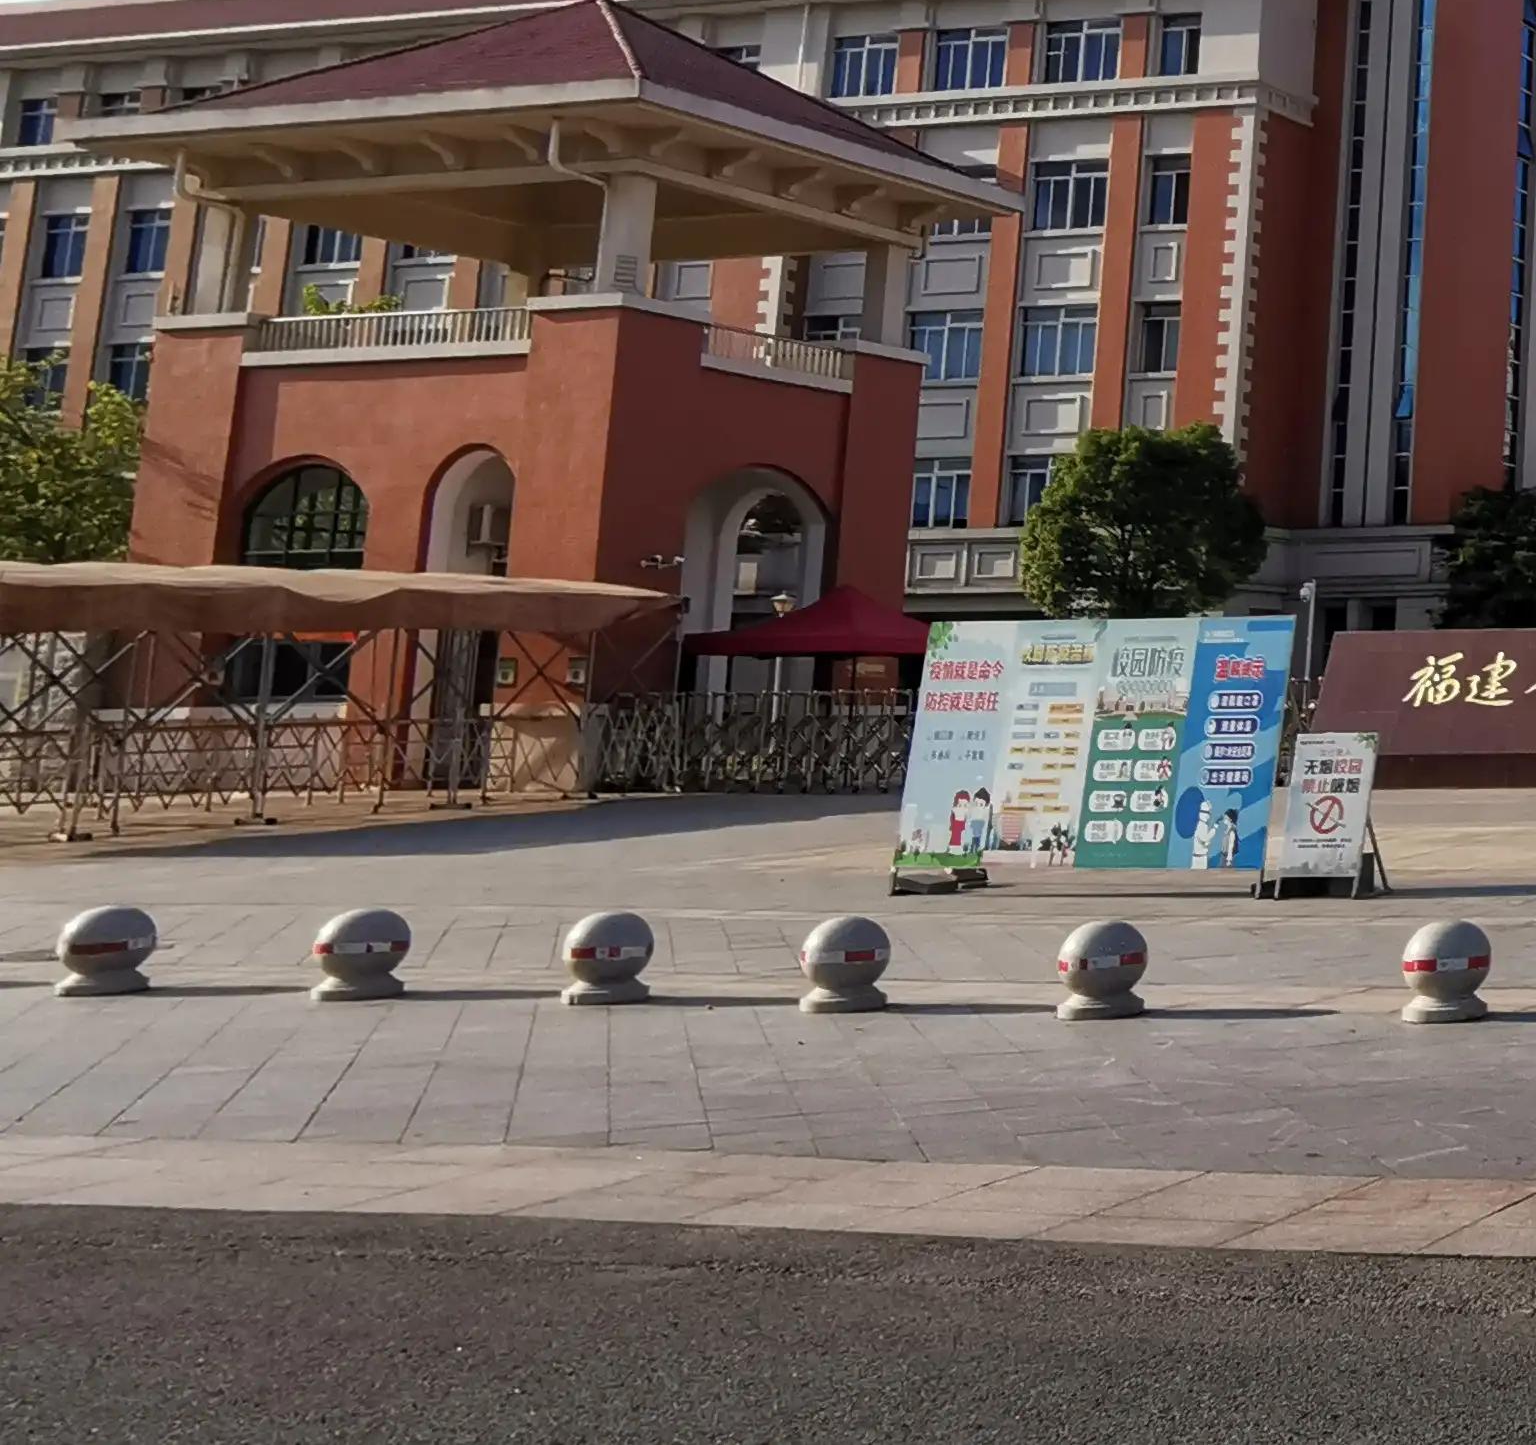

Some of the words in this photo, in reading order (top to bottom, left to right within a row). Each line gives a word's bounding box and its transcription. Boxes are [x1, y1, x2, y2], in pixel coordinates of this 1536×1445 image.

[930, 660, 1004, 681] 疫情就是命令
[1111, 646, 1186, 678] 校园防疫
[925, 691, 999, 712] 防控就是责任
[1304, 759, 1363, 775] 无烟校园
[1302, 778, 1360, 794] 禁止吸烟
